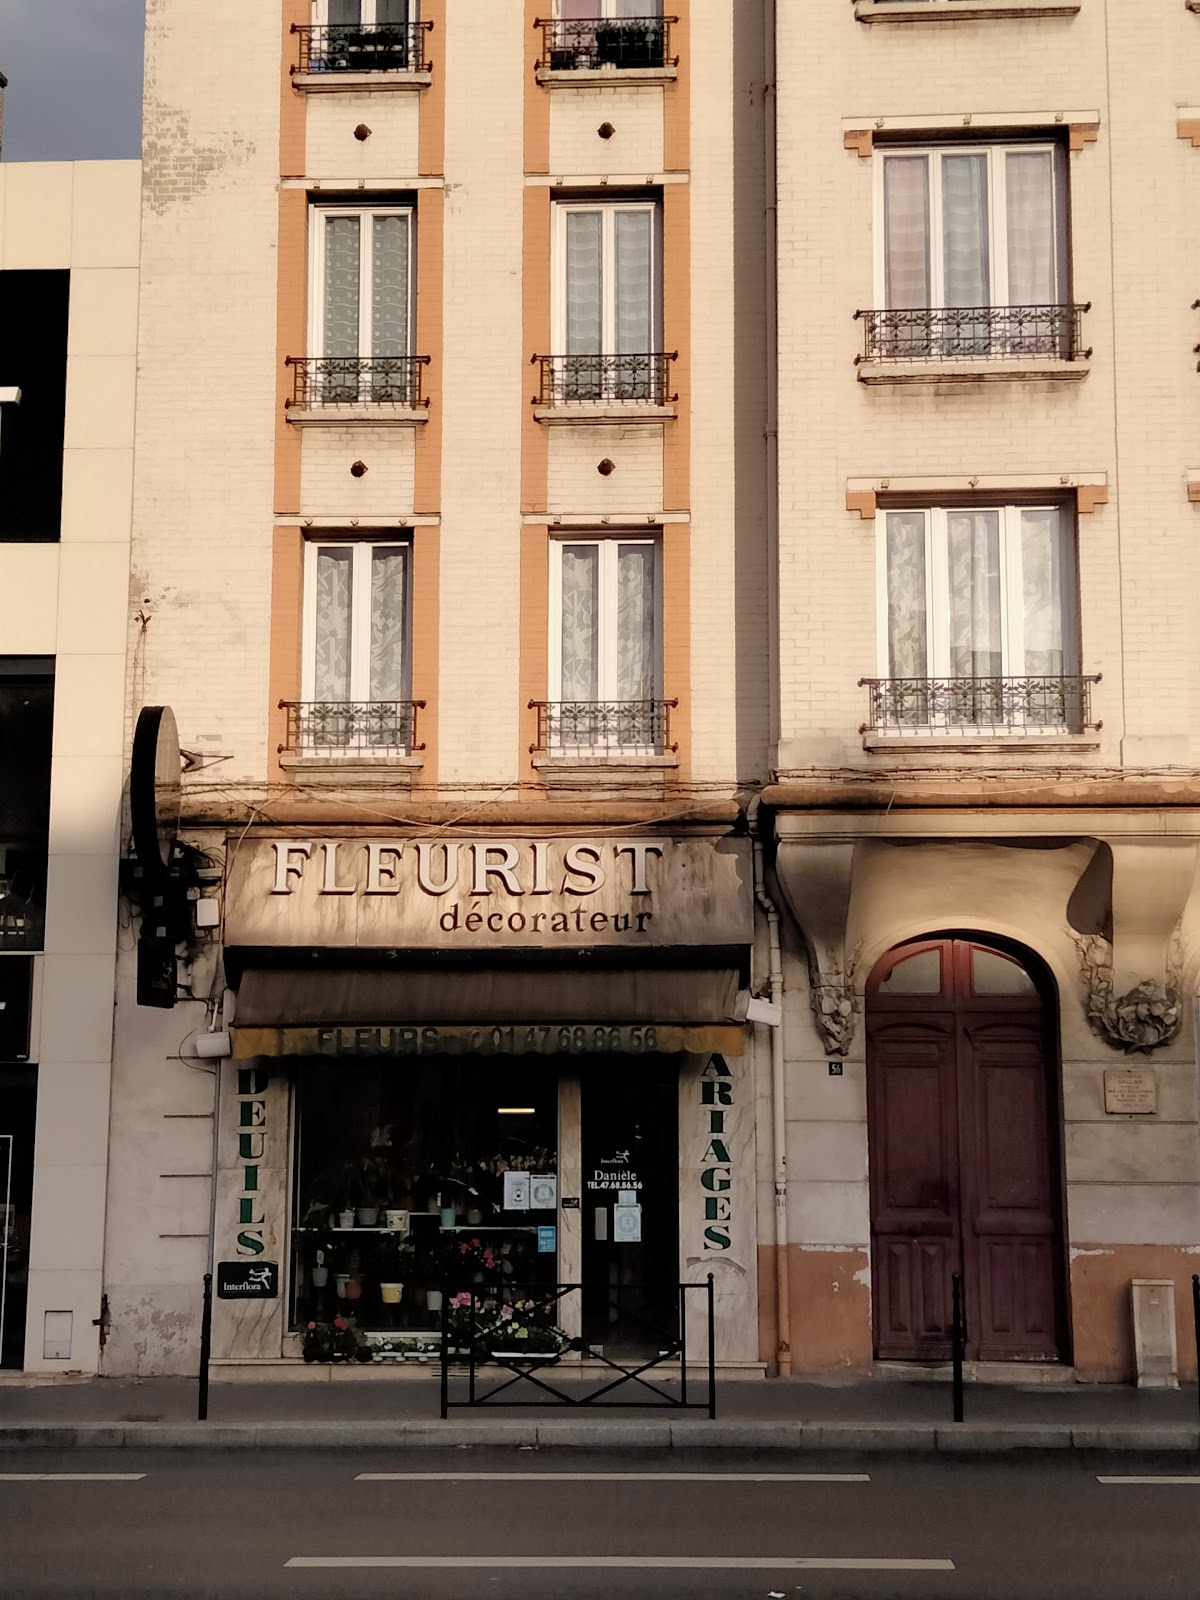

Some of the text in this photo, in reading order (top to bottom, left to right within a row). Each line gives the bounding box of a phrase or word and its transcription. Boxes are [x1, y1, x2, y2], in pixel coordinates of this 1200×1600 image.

[270, 841, 665, 896] FLEURIST
[439, 901, 653, 933] décorateur
[317, 1027, 439, 1054] FLEURS
[558, 1027, 586, 1051] 68
[630, 1027, 658, 1051] 56
[831, 1063, 841, 1074] 56
[236, 1068, 269, 1256] DEUILS
[594, 1169, 637, 1181] Danièle
[223, 1281, 262, 1291] Interflora
